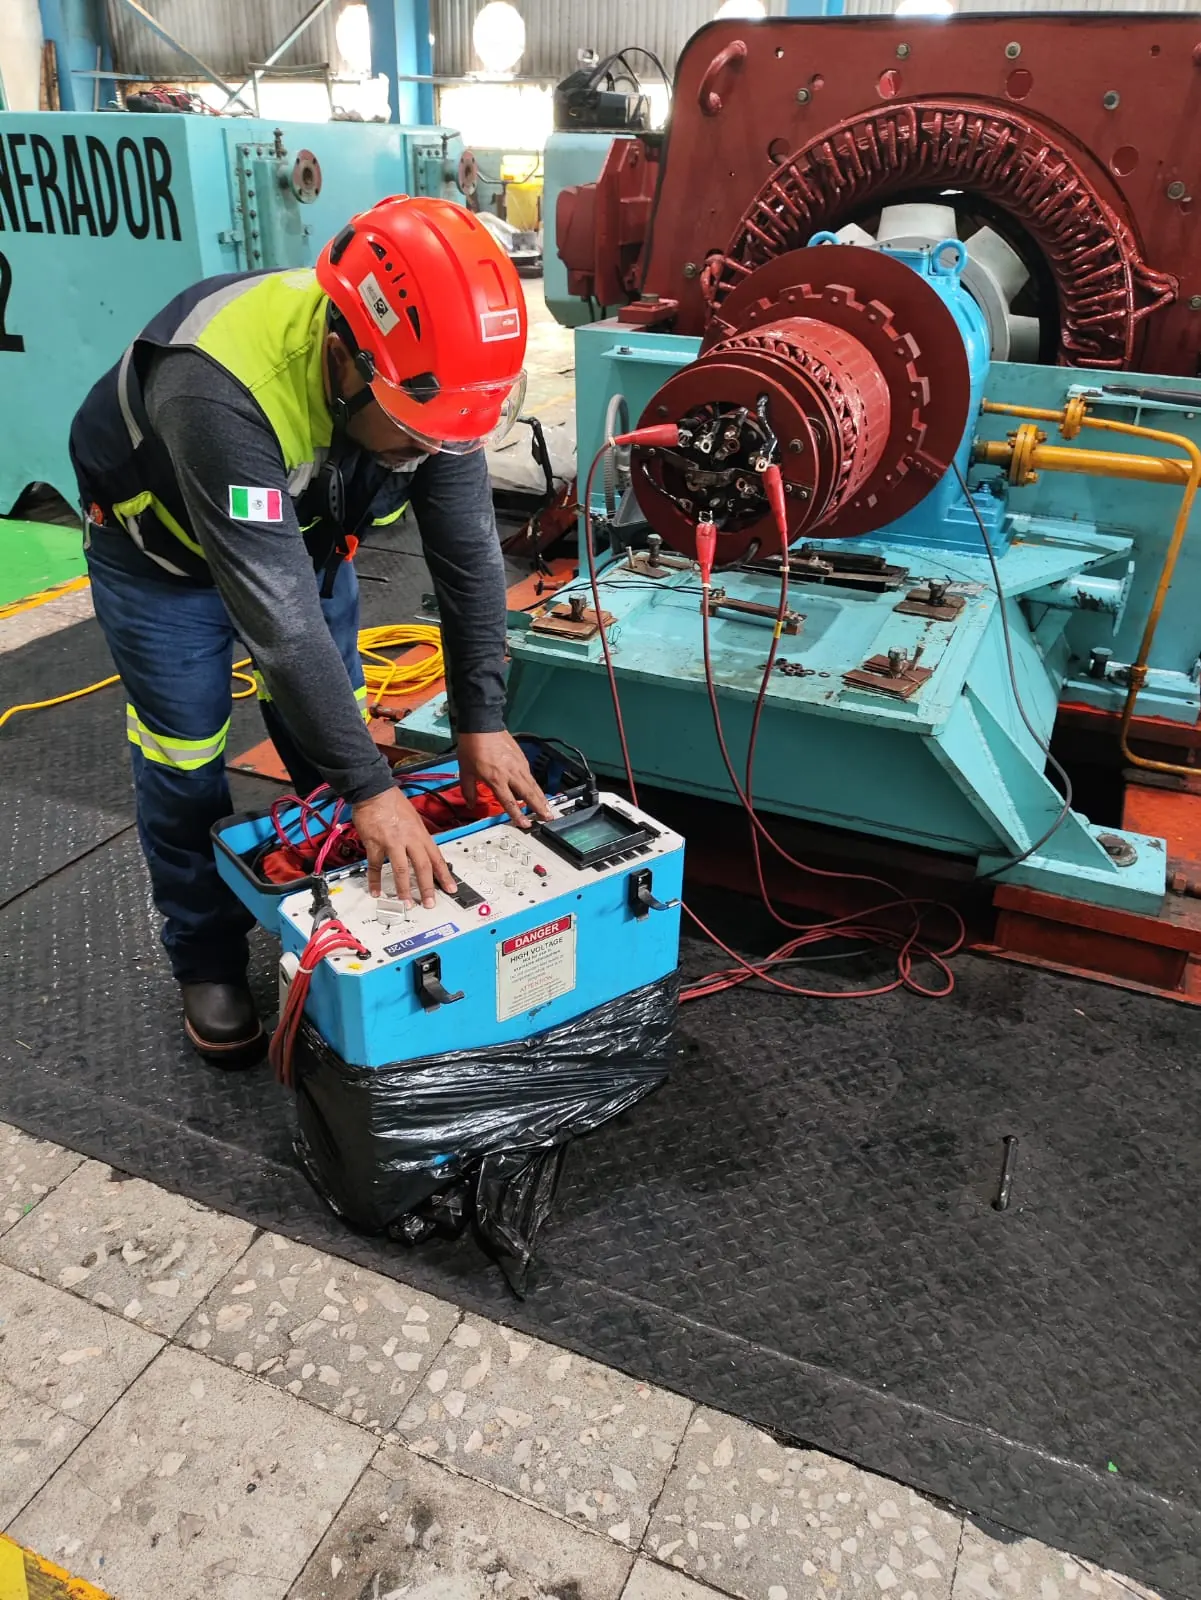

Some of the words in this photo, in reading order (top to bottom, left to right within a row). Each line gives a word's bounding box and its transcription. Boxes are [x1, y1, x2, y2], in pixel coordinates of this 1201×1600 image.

[515, 923, 560, 948] DANGER
[510, 950, 529, 963] HIGH
[530, 937, 563, 954] VOLTAGE
